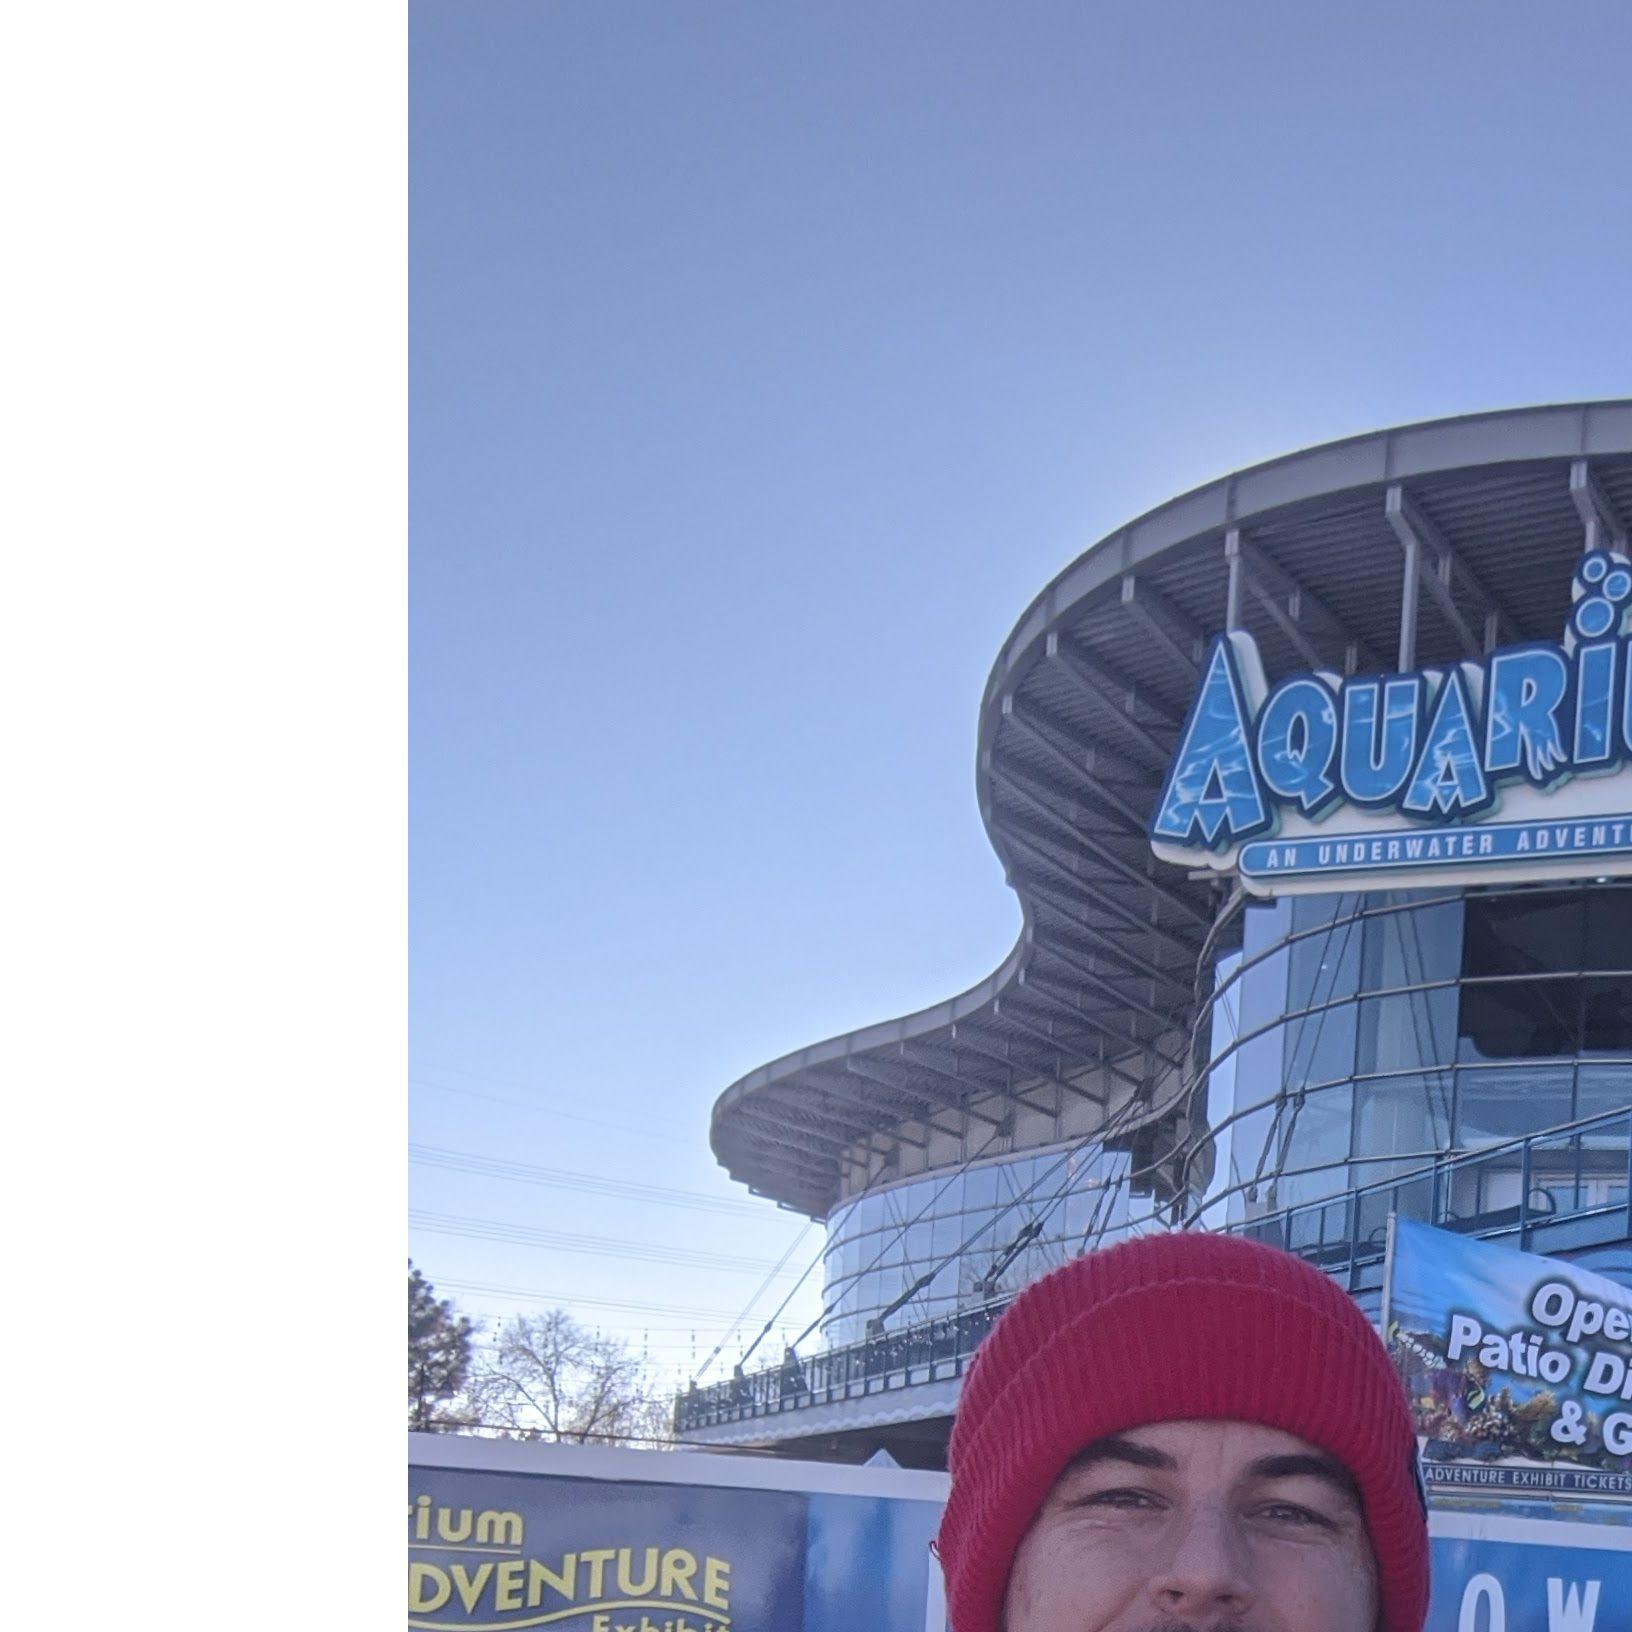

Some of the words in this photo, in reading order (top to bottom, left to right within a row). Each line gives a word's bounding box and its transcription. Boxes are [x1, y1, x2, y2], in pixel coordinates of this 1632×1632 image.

[1265, 847, 1297, 868] AN
[1318, 834, 1494, 865] UNDERWATER
[1446, 1315, 1572, 1384] Patio
[1550, 1400, 1587, 1446] &
[1425, 1467, 1505, 1485] ADVENTURE
[1512, 1471, 1566, 1488] EXHIBIT
[1574, 1475, 1632, 1491] TICKETS
[408, 1548, 731, 1615] DVENTURE
